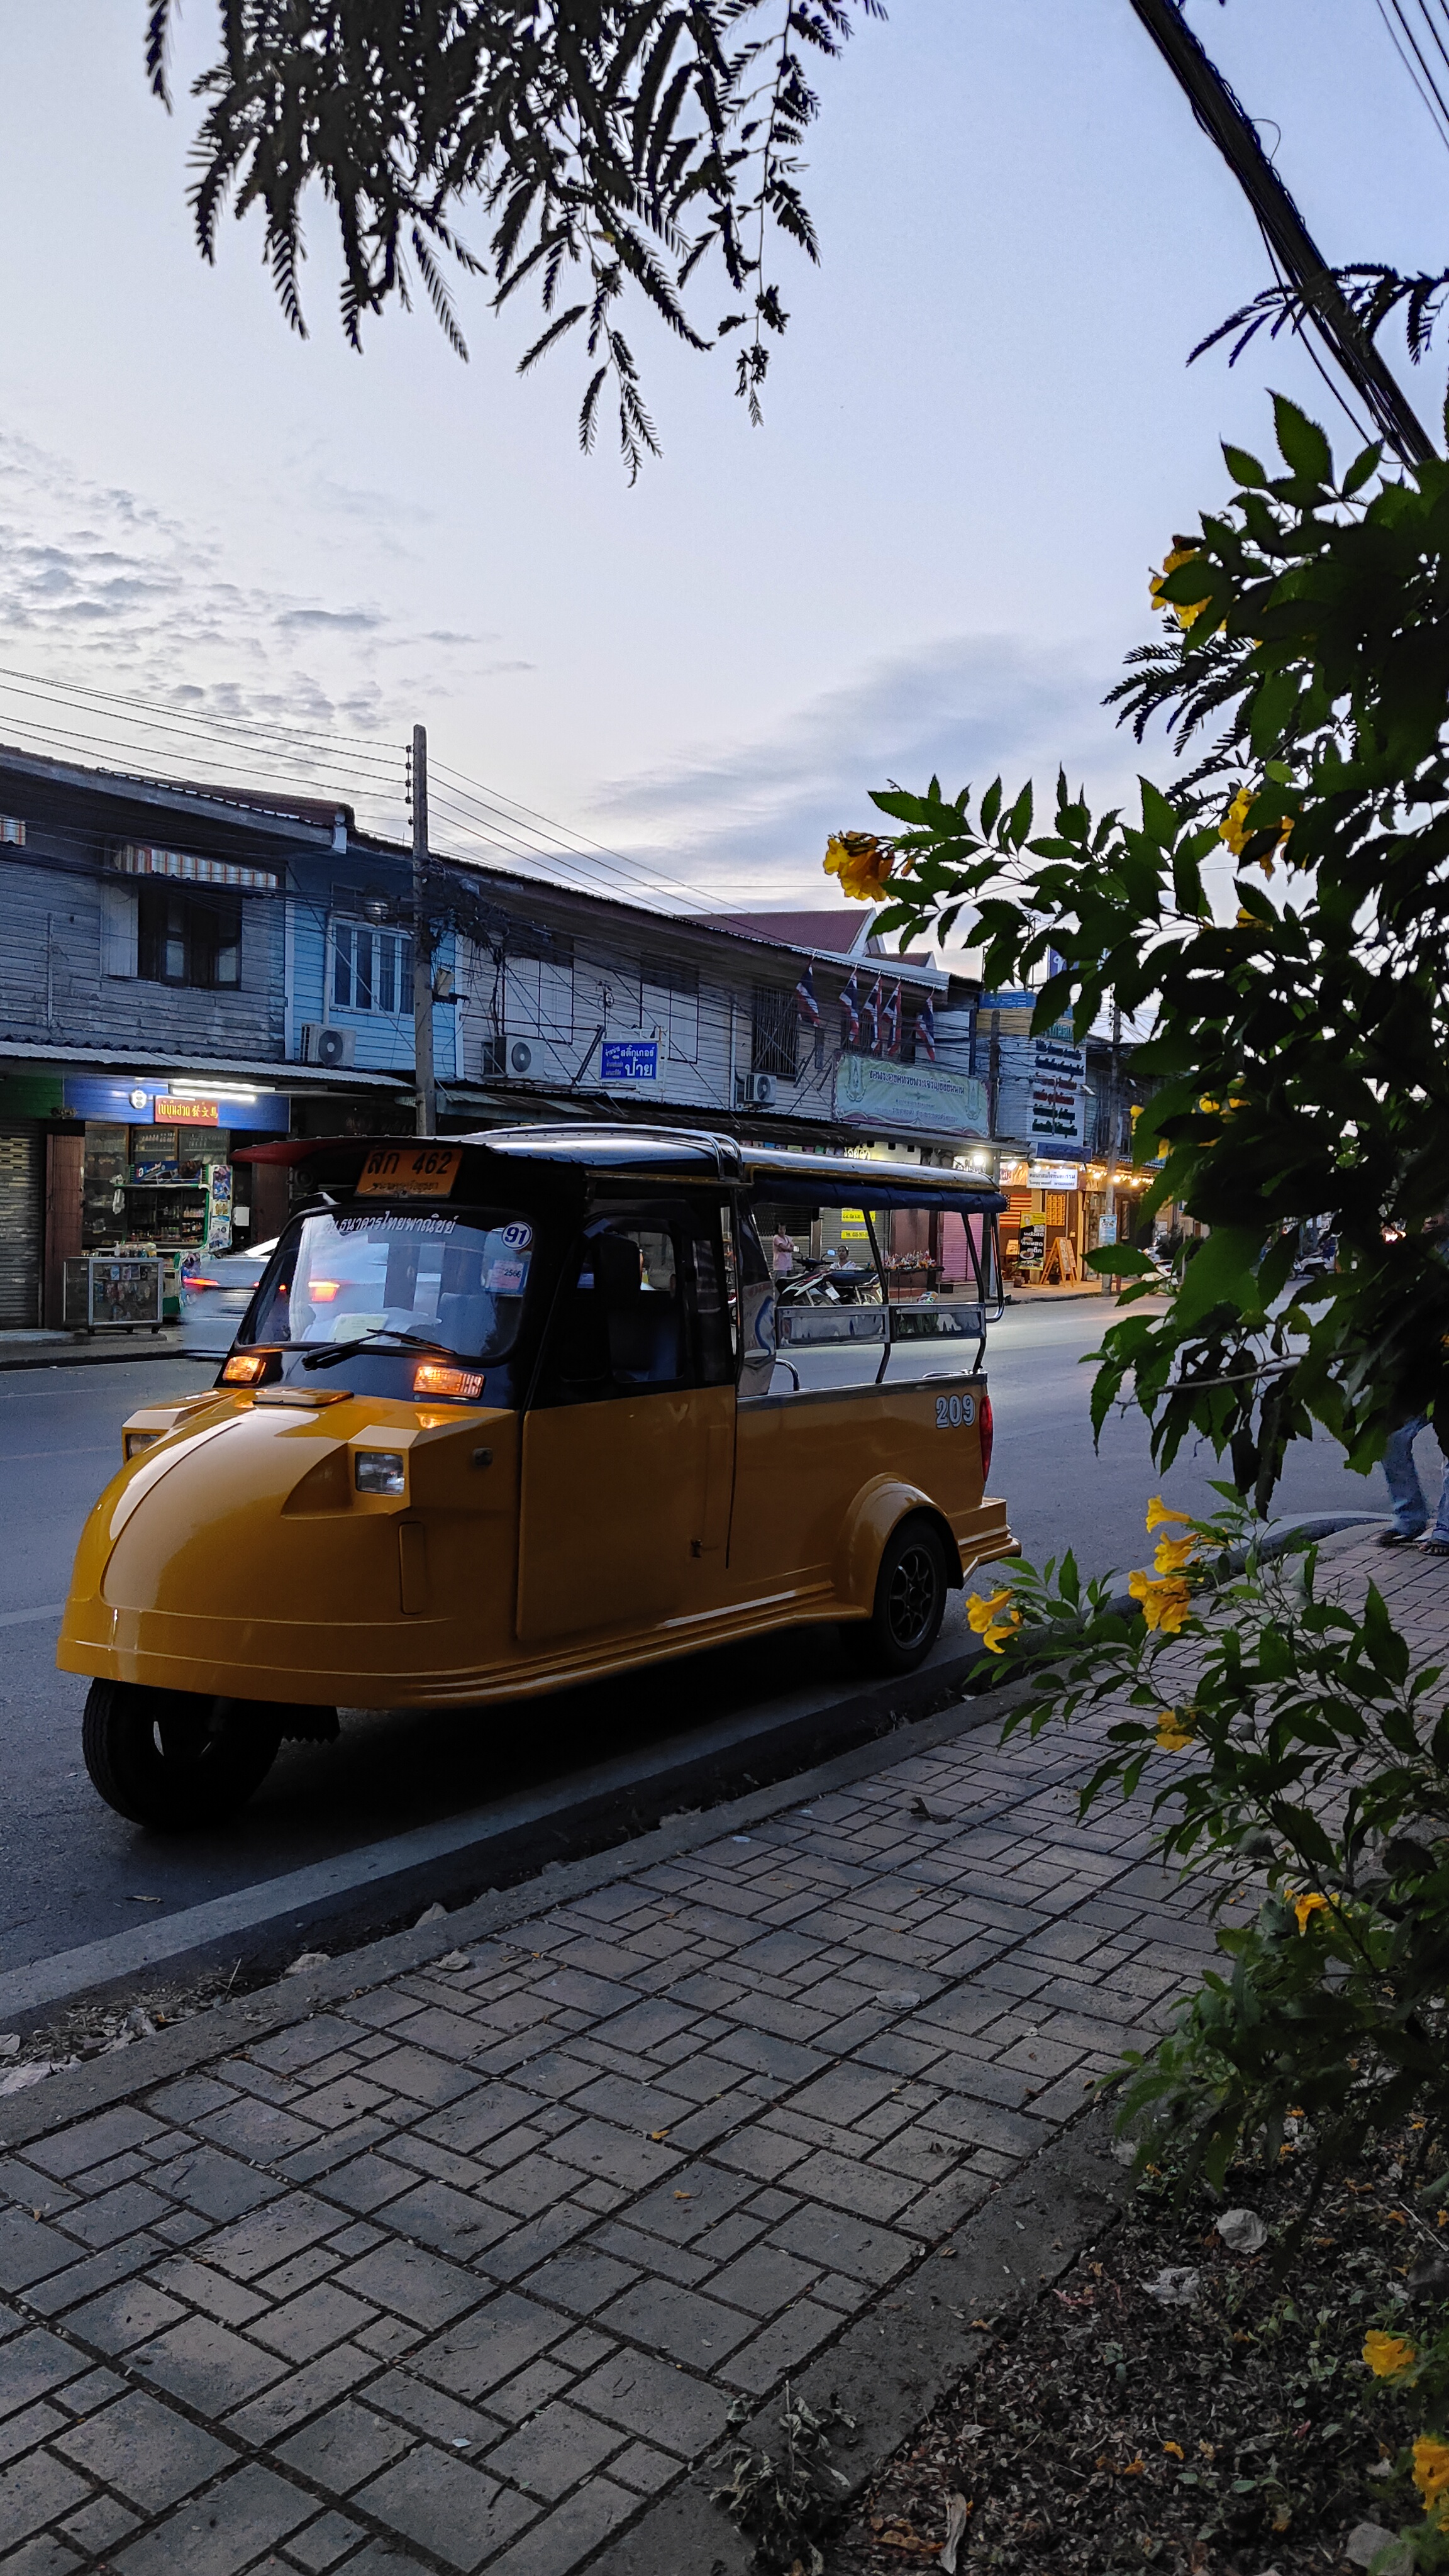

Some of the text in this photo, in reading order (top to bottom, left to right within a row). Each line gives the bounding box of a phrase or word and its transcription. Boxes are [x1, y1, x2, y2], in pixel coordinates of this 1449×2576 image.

[625, 1057, 653, 1076] ป้าย
[367, 1152, 452, 1174] สก 462
[340, 1211, 458, 1233] ธนาคารไทยพาณิชย์
[505, 1227, 527, 1245] 91
[504, 1270, 521, 1278] 2566
[936, 1394, 975, 1429] 209
